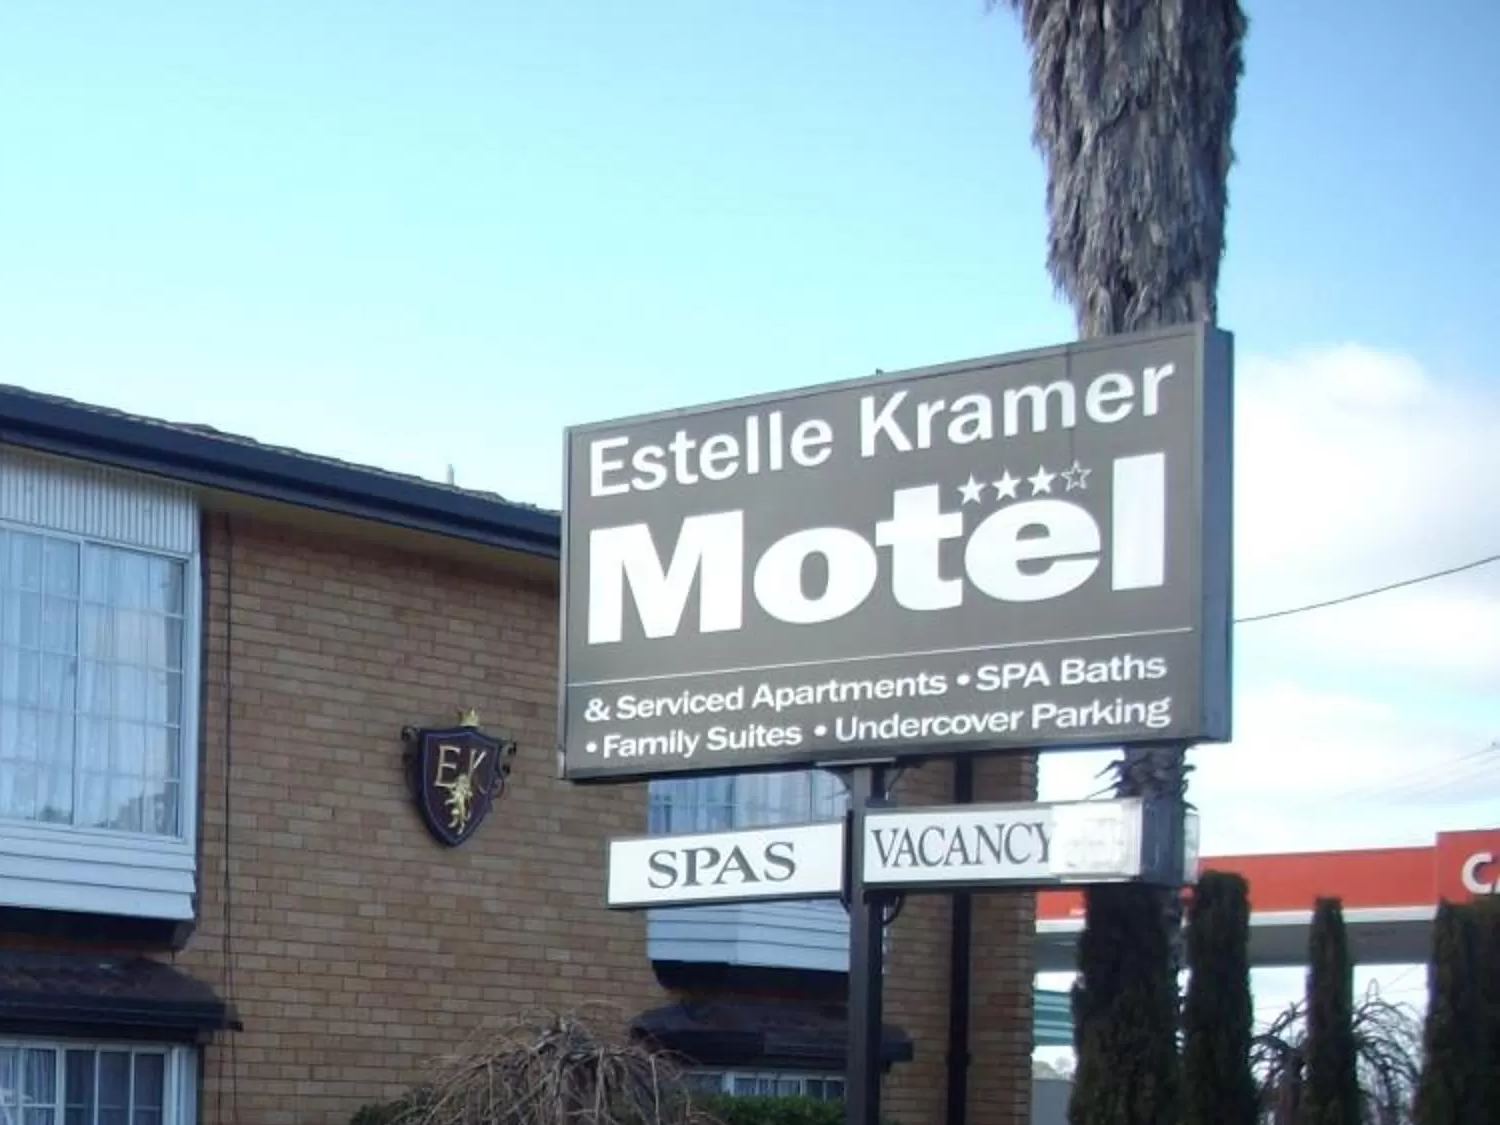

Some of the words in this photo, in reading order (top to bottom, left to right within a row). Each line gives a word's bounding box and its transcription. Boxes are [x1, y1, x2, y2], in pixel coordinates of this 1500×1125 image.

[589, 410, 833, 497] Estelle
[860, 363, 1175, 457] Kramer
[587, 453, 1166, 645] Motel
[583, 698, 611, 722] &
[616, 686, 744, 719] Serviced
[751, 672, 948, 711] Apartments
[976, 662, 1051, 691] SPA
[1060, 654, 1168, 686] Baths
[603, 729, 700, 758] Family
[706, 725, 803, 751] Suites
[835, 711, 1025, 742] Undercover
[1031, 697, 1173, 729] Parking
[647, 842, 797, 888] SPAS
[872, 822, 1051, 868] VACANCY
